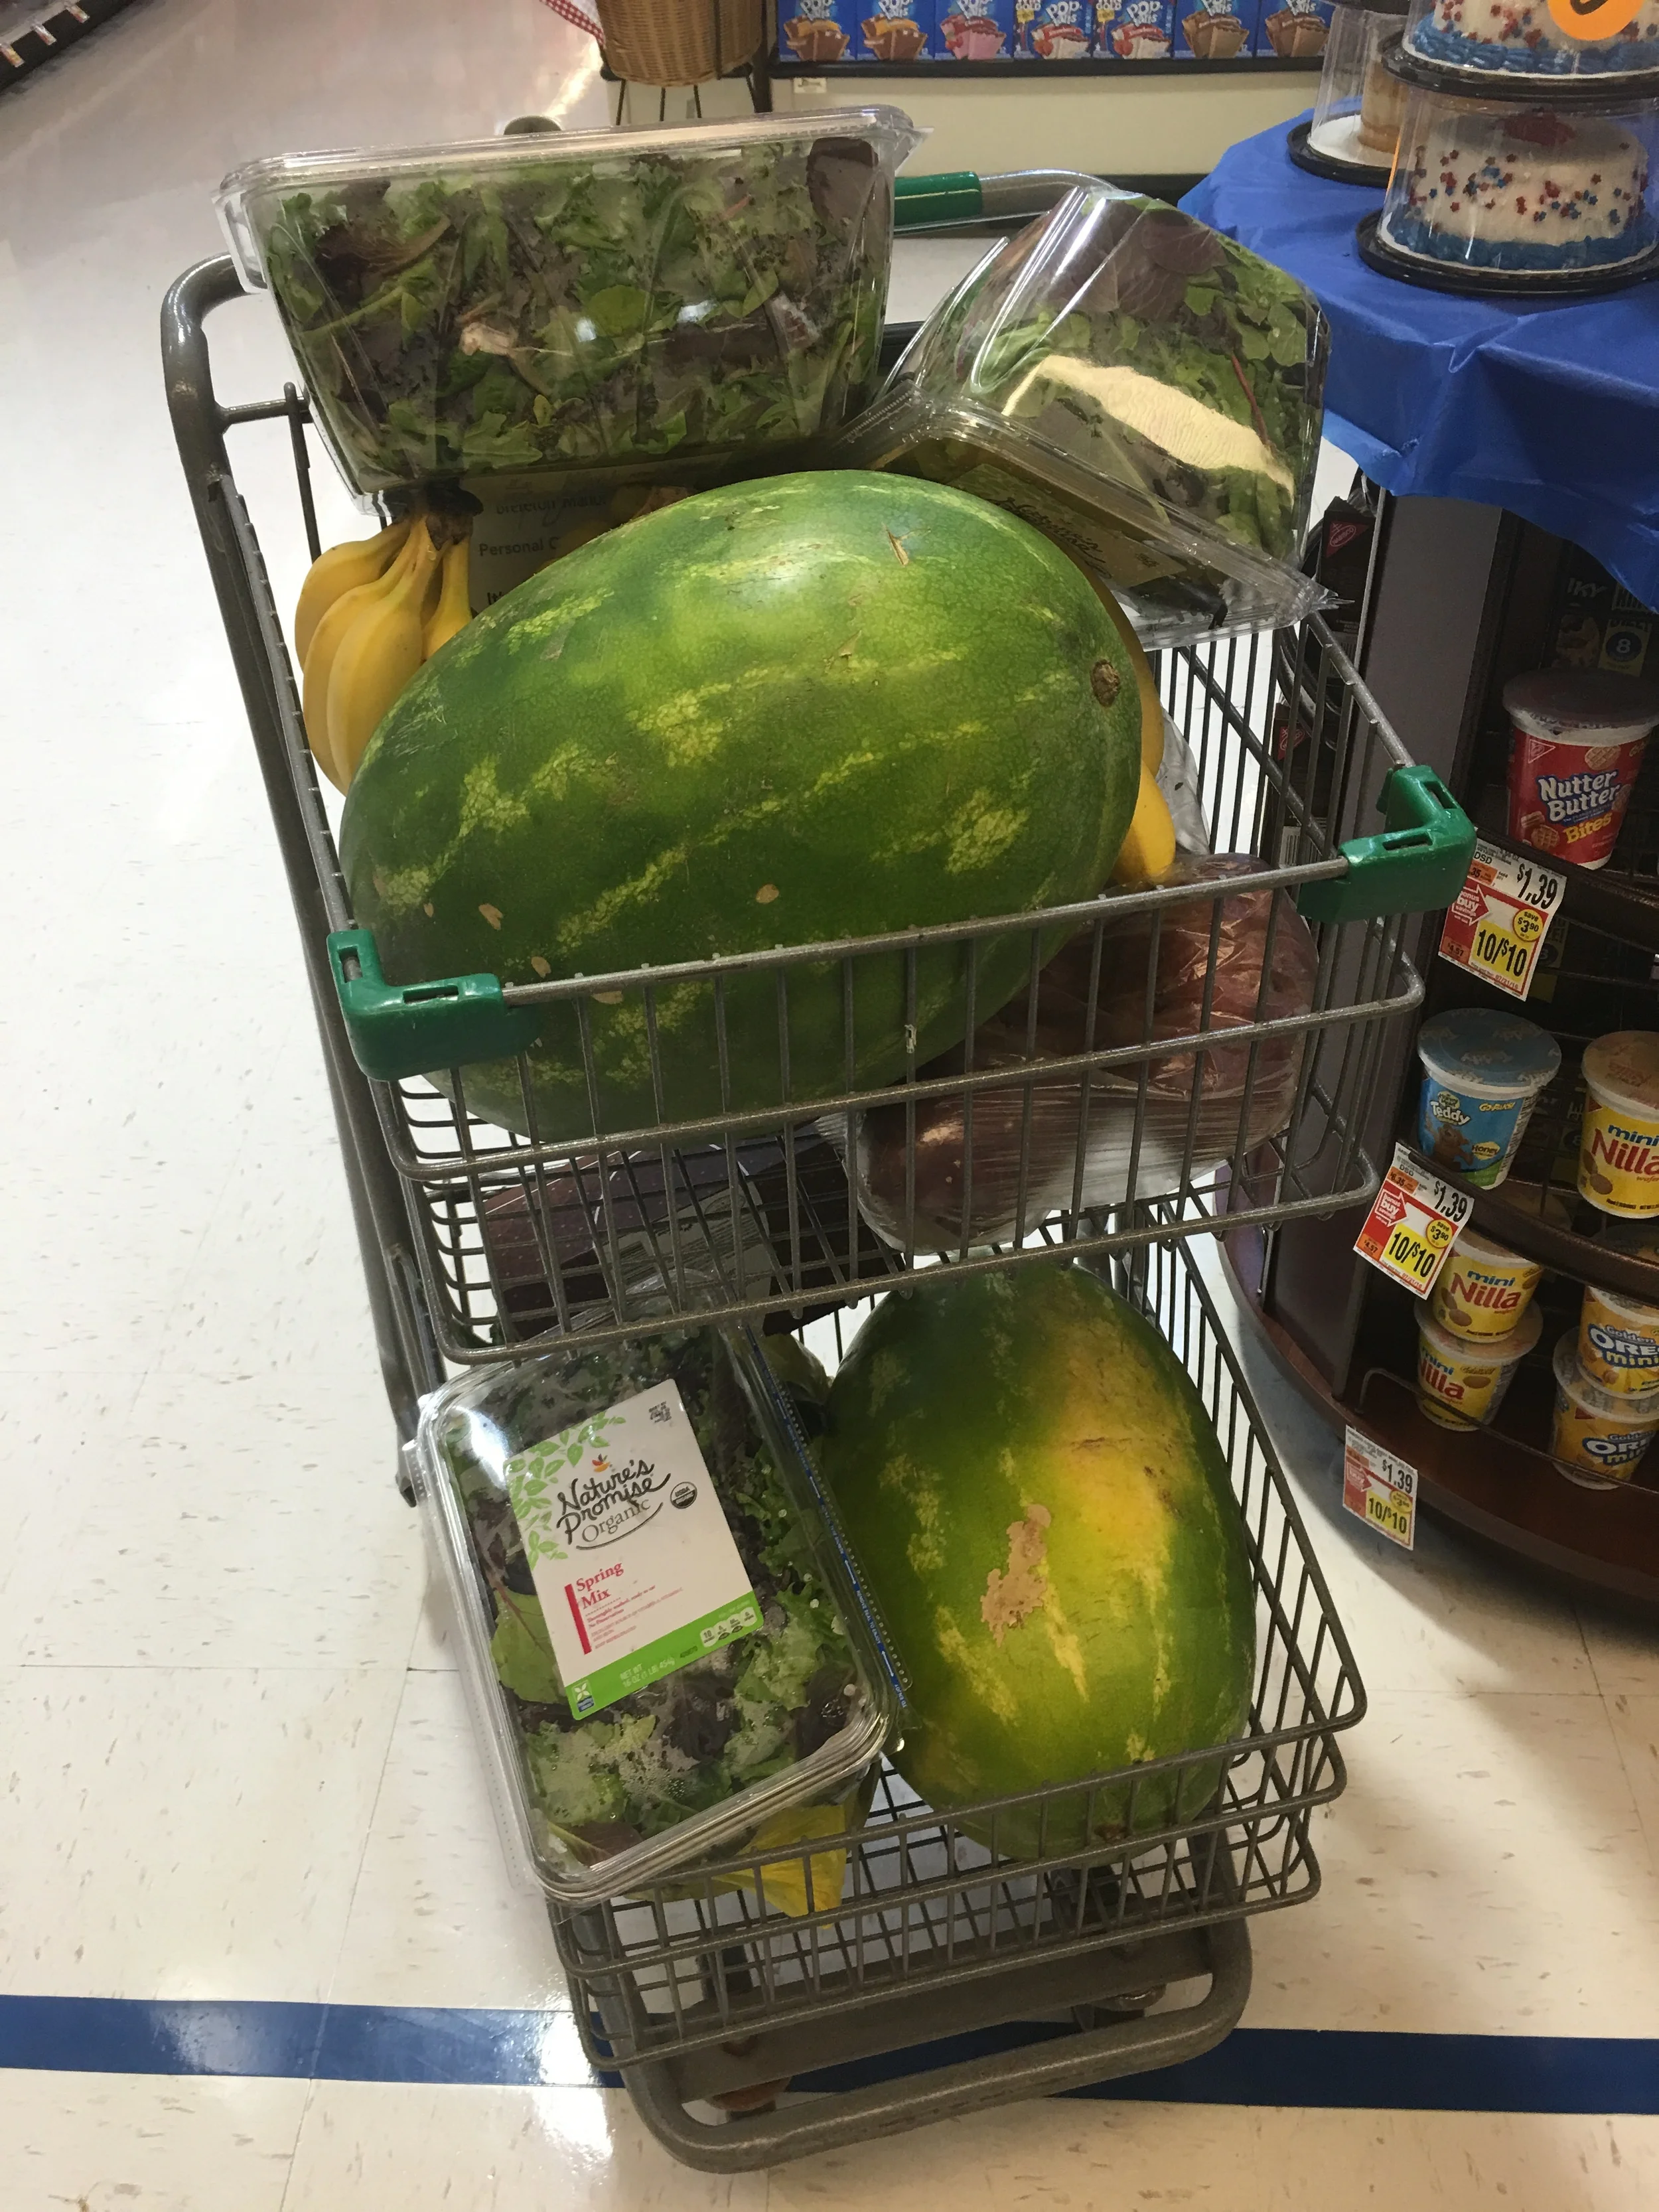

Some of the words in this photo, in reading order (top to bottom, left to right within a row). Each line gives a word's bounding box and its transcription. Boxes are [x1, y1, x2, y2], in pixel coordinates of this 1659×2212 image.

[479, 538, 543, 557] Personal
[1616, 638, 1631, 654] 8
[1538, 771, 1618, 801] Nutter
[1547, 784, 1621, 822] Butter
[1563, 812, 1613, 844] Bites
[1473, 851, 1493, 865] DSD
[1517, 863, 1558, 910] $1.39
[1524, 911, 1539, 921] save
[1478, 928, 1528, 977] 10/$10
[1430, 1101, 1471, 1125] Teddy
[1608, 1124, 1659, 1147] mini
[1472, 1145, 1498, 1154] Honey
[1591, 1128, 1659, 1175] Nilla
[1400, 1164, 1414, 1177] DSD
[1380, 1201, 1400, 1215] buy
[1433, 1180, 1468, 1222] $1.39
[1437, 1221, 1450, 1232] save
[1388, 1232, 1436, 1278] 10/$10
[1467, 1270, 1516, 1286] mini
[1450, 1272, 1522, 1310] Nilla
[1590, 1328, 1659, 1355] ORE
[1606, 1325, 1655, 1343] Golden
[557, 1459, 655, 1515] Nature's
[1382, 1459, 1413, 1494] $1.39
[556, 1473, 671, 1545] Promise
[582, 1499, 651, 1542] Organic
[1368, 1497, 1407, 1534] 10/$10
[576, 1562, 624, 1591] Spring
[581, 1588, 611, 1609] Mix
[703, 1629, 712, 1639] 10
[620, 1669, 632, 1680] NET
[632, 1663, 642, 1674] WT
[622, 1679, 631, 1688] 16
[632, 1674, 641, 1683] OZ
